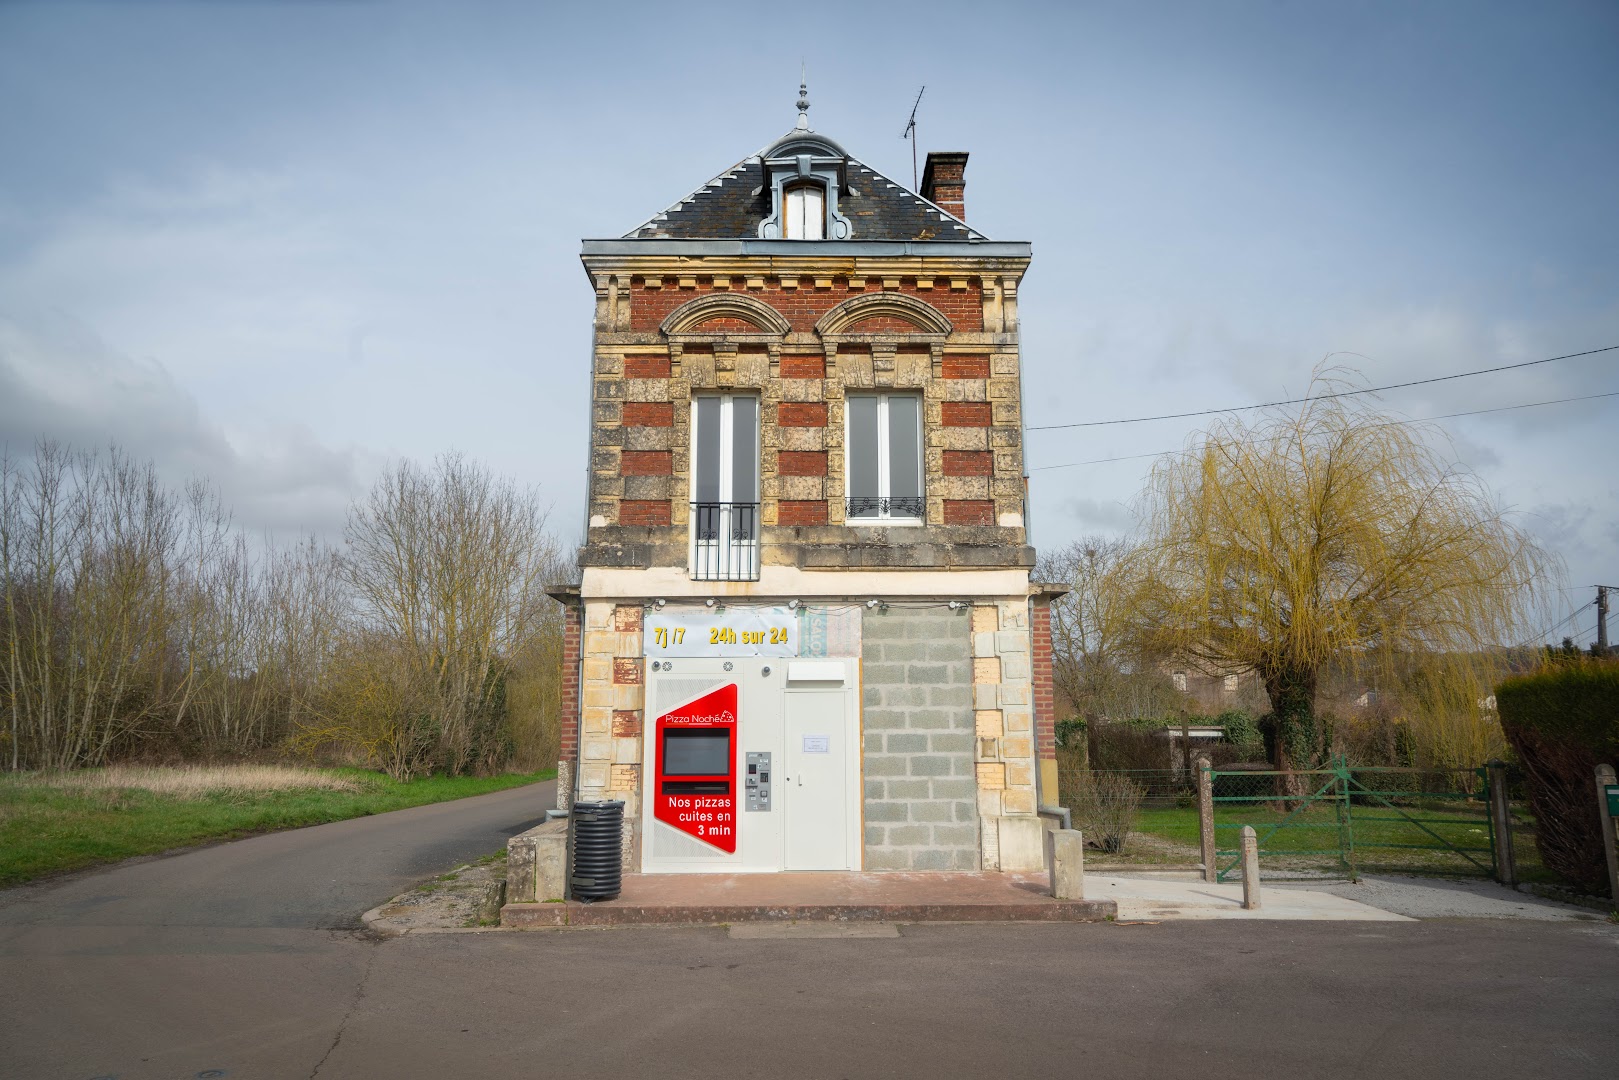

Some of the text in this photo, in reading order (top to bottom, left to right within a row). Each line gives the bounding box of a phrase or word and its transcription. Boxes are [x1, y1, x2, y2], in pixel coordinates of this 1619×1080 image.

[709, 627, 737, 645] 24h
[741, 629, 766, 645] sur
[769, 627, 789, 645] 24
[665, 713, 720, 723] Pizza Noché
[669, 796, 731, 810] Nos pizzas
[679, 810, 731, 822] cuites en
[697, 824, 731, 836] 3 min
